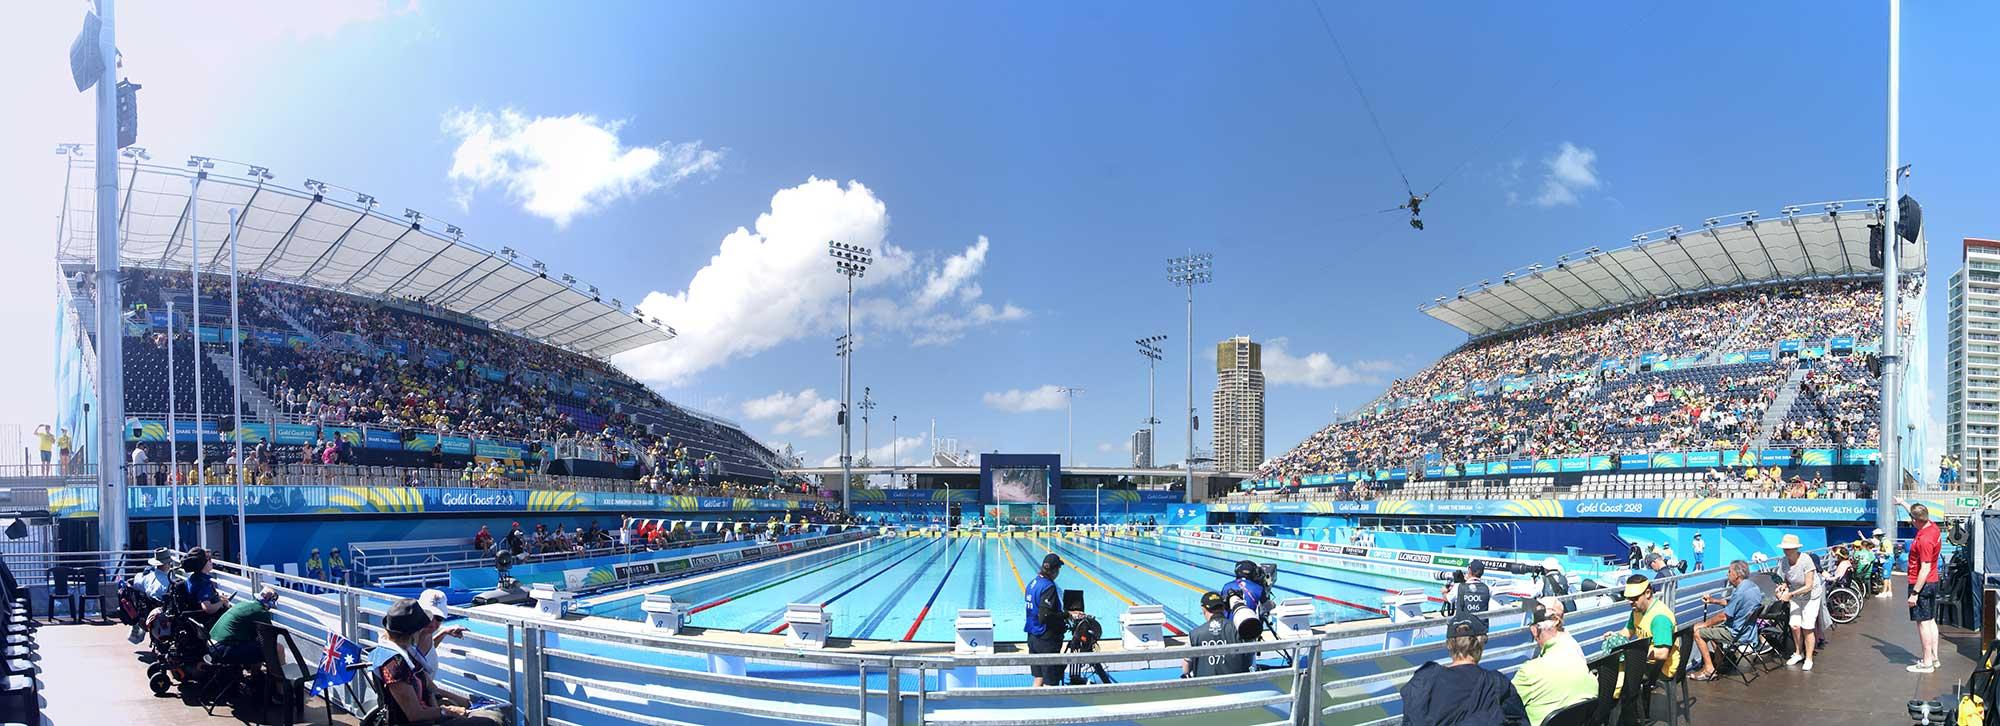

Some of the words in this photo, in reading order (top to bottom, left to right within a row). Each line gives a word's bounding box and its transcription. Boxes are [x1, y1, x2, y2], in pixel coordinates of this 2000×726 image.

[167, 496, 200, 506] SARE
[223, 496, 258, 505] DRAM
[442, 492, 468, 507] Gold
[470, 493, 494, 506] Coast
[1576, 502, 1599, 513] Gold
[1600, 502, 1624, 513] Coast
[1787, 506, 1852, 514] COMMONWEALTH
[1854, 506, 1879, 514] GAME
[1463, 594, 1482, 602] POOL
[800, 632, 809, 641] 7
[1141, 633, 1150, 643] 5
[969, 638, 978, 648] 6
